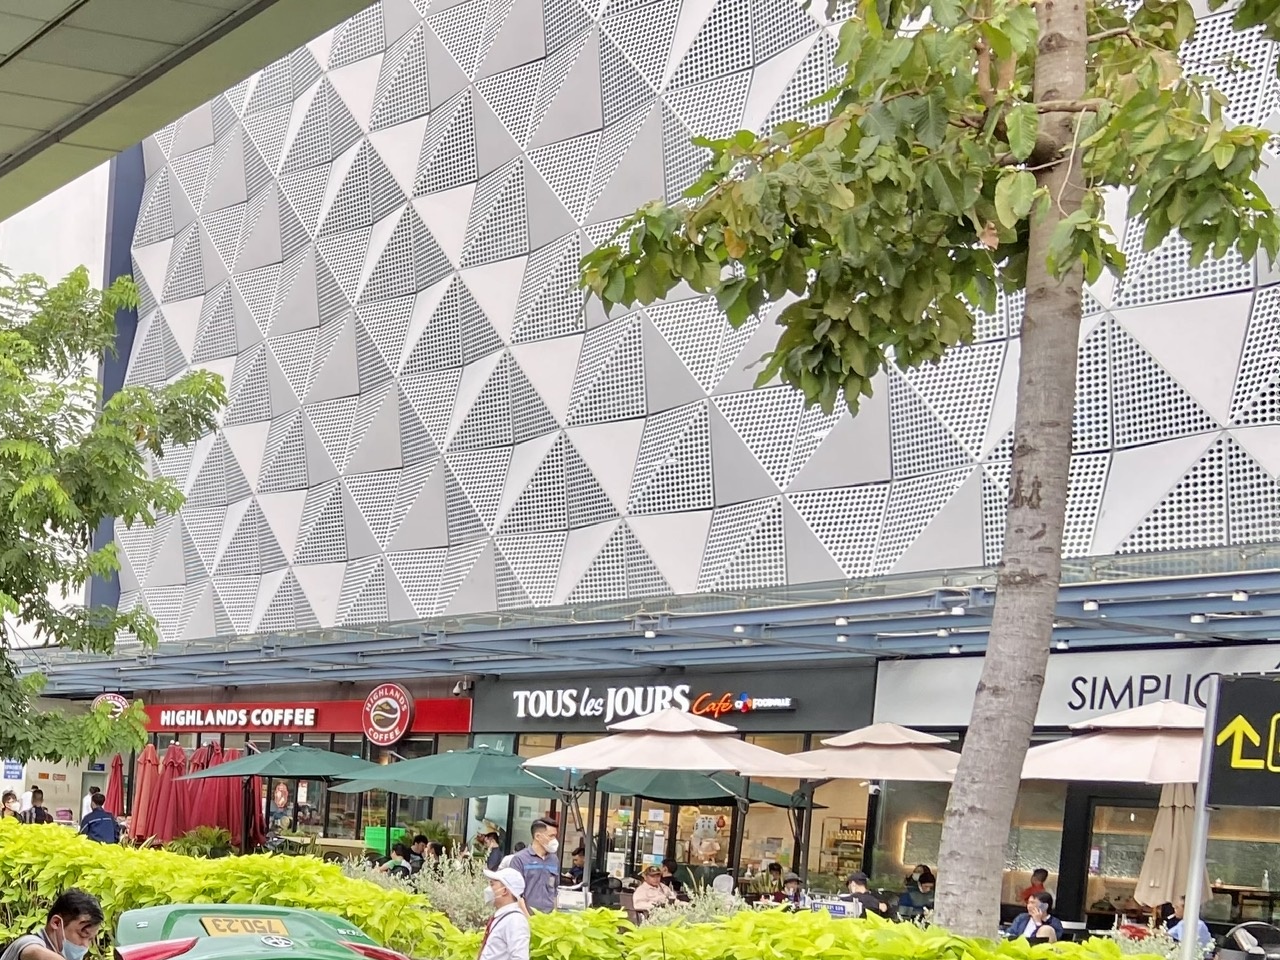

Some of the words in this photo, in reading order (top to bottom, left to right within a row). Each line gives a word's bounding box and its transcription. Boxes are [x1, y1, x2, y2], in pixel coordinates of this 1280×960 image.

[365, 687, 408, 713] HIGHLANDS
[513, 689, 577, 718] TOUS
[579, 687, 604, 717] les
[604, 684, 691, 723] JOURS
[692, 692, 733, 718] Café
[160, 708, 247, 726] HIGHLANDS
[251, 708, 316, 726] COFFEE
[368, 725, 401, 742] COFFEE
[211, 917, 281, 934] 750.23
